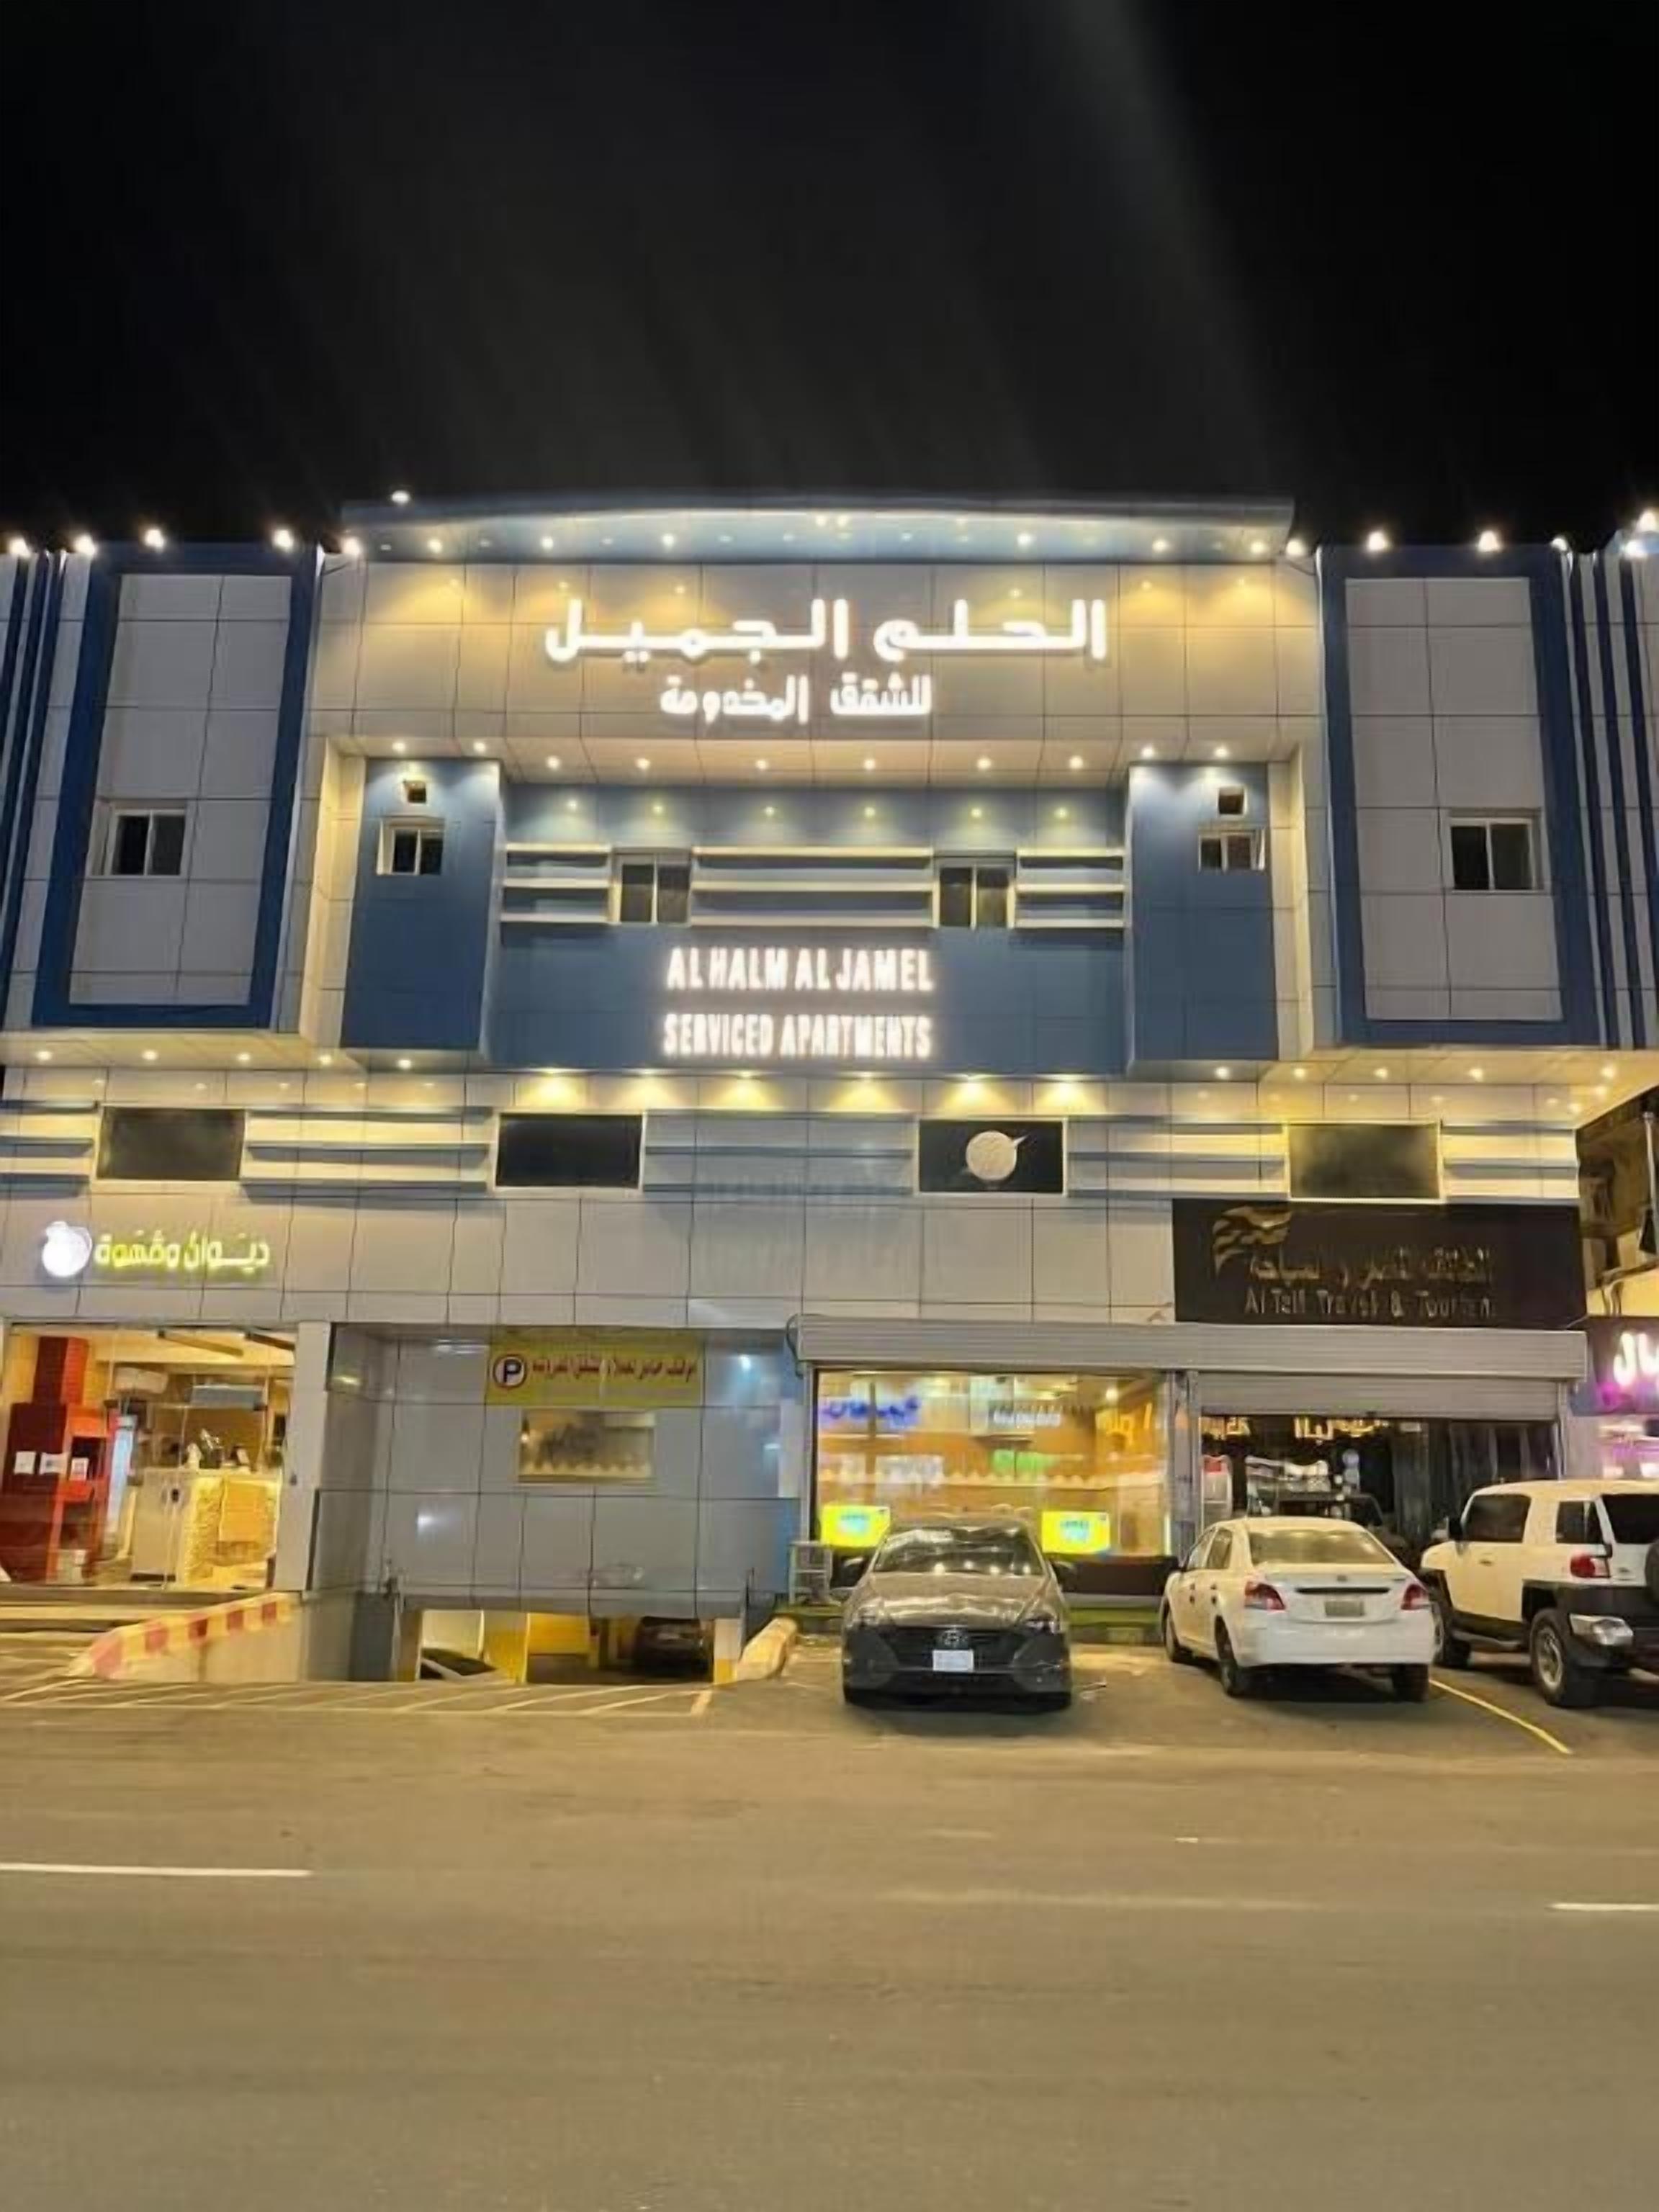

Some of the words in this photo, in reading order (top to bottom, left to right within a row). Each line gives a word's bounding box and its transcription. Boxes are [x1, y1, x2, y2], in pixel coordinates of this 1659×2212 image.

[544, 598, 849, 665] الجميل
[873, 599, 1107, 660] الحلم
[660, 673, 809, 725] المخدومة
[830, 671, 932, 716] للشقق
[667, 947, 703, 991] AL
[709, 947, 789, 991] HALM
[794, 948, 831, 991] AL
[835, 948, 934, 992] JAMEL
[662, 1013, 775, 1056] SERVICED
[779, 1014, 932, 1058] APARTMENTS
